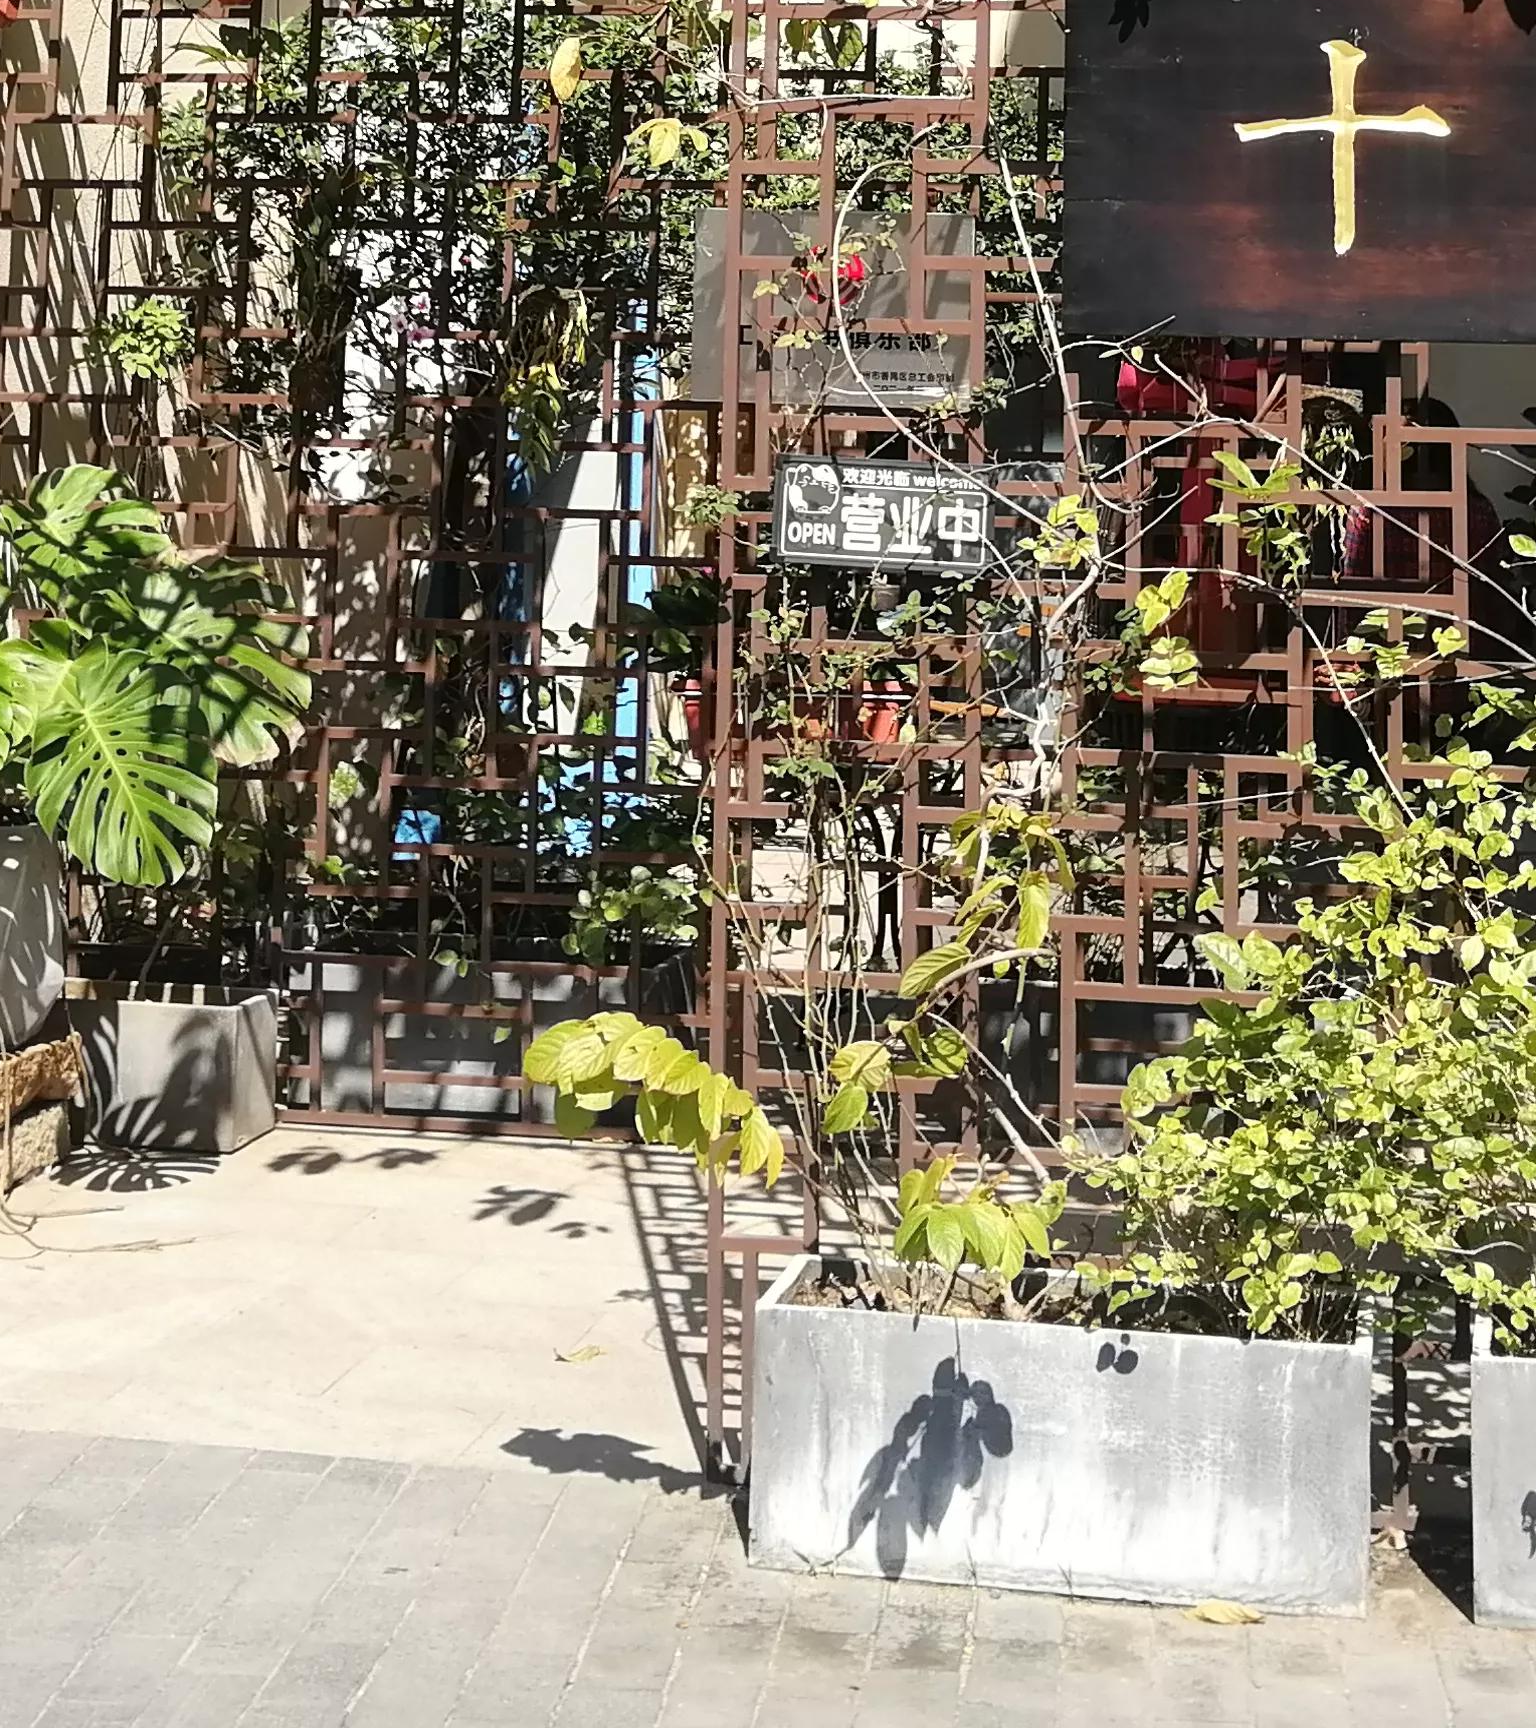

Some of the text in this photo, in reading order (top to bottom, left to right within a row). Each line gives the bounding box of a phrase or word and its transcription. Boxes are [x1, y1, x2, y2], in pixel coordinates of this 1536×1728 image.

[787, 520, 836, 546] OPEN
[841, 492, 981, 559] 营业中
